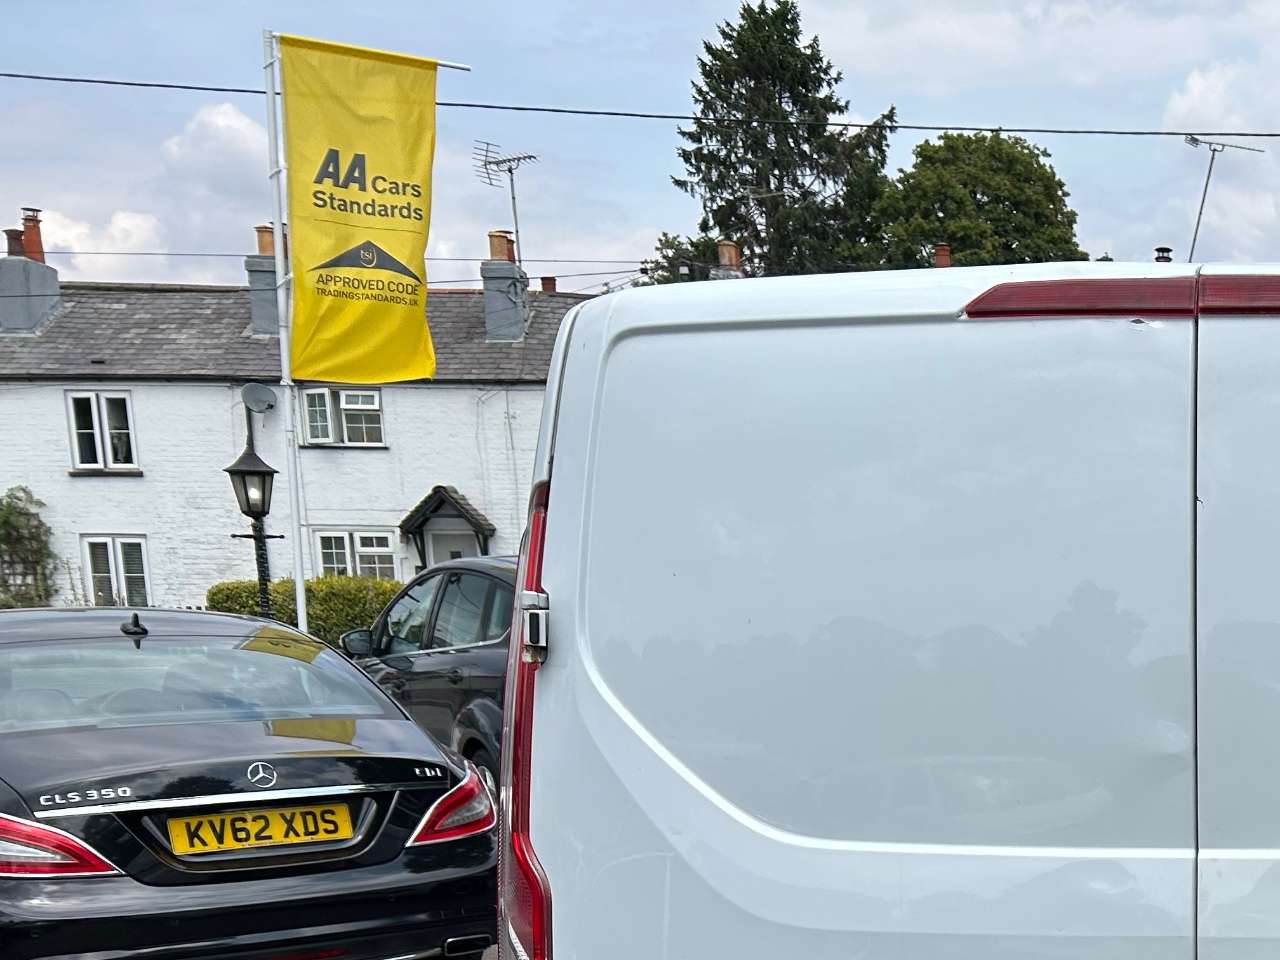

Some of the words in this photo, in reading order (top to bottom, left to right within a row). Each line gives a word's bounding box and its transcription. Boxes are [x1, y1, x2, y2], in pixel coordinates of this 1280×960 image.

[313, 148, 367, 192] AA
[371, 175, 422, 198] Cars
[312, 190, 424, 221] Standards
[316, 273, 385, 291] APPROVED
[387, 281, 419, 296] CODE
[316, 287, 419, 306] TRADINGSTANDARDS.UK
[40, 792, 81, 806] CLS
[85, 787, 131, 800] 350
[184, 814, 273, 849] KV62
[280, 809, 339, 839] XDS
